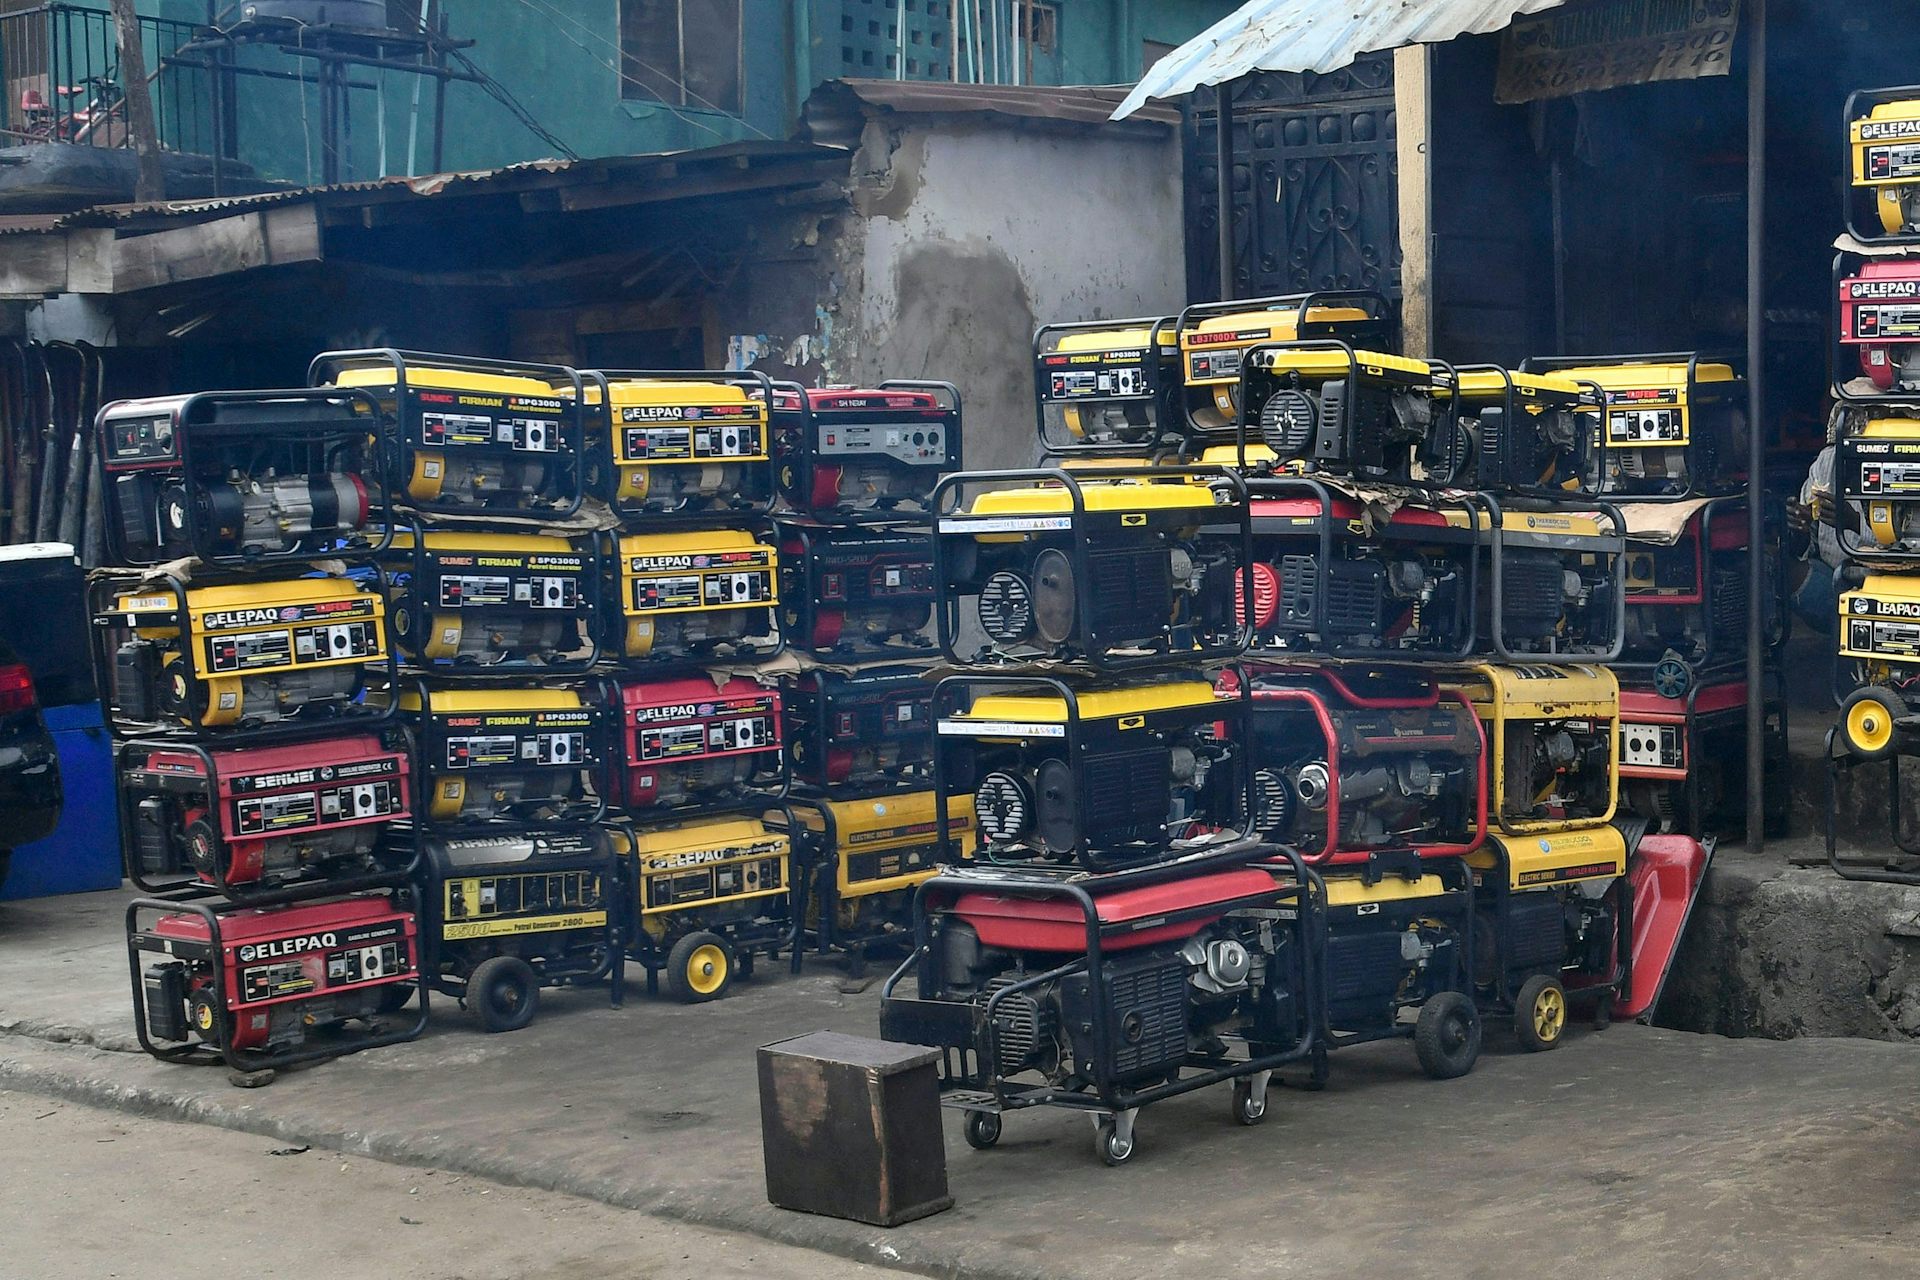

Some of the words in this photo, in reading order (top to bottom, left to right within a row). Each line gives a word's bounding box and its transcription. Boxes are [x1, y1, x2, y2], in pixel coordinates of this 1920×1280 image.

[1862, 282, 1916, 294] ELEPAQ
[459, 396, 503, 406] FIRMAN
[518, 398, 561, 408] SPG3000
[633, 407, 682, 418] ELEPAQ
[1856, 444, 1888, 453] SUMEC
[439, 557, 472, 566] SUMEC
[478, 557, 522, 567] FIRMAN
[642, 556, 691, 567] ELEPAQ
[217, 608, 278, 624] ELEPAQ
[647, 705, 696, 718] ELEPAQ
[448, 718, 480, 726] SUMEC
[486, 716, 530, 726] FIRMAN
[446, 923, 490, 938] 2500
[257, 933, 337, 959] ELEPAQ
